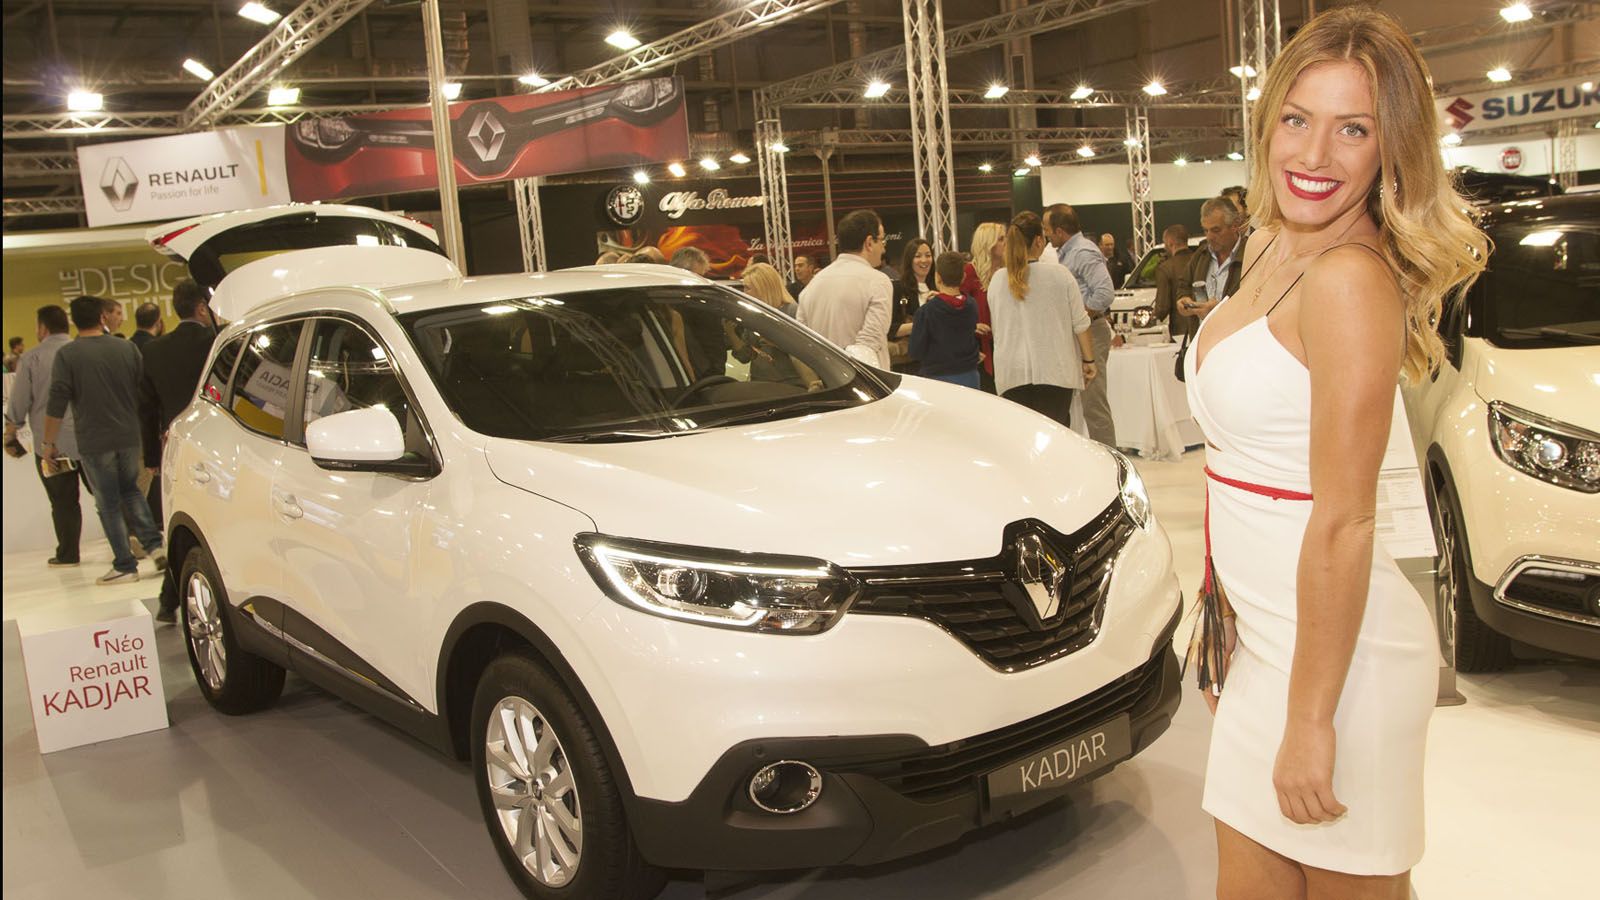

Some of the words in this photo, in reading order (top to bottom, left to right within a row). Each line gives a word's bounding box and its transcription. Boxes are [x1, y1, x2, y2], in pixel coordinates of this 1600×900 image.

[149, 164, 239, 187] RENAULT
[151, 189, 187, 200] Passion
[189, 187, 202, 197] for
[204, 184, 219, 195] life
[659, 191, 705, 219] Alfa
[747, 238, 765, 251] La
[80, 261, 193, 297] DESIG
[70, 654, 148, 682] Renault
[43, 676, 152, 716] KADJAR
[1021, 732, 1106, 792] KADJAR
